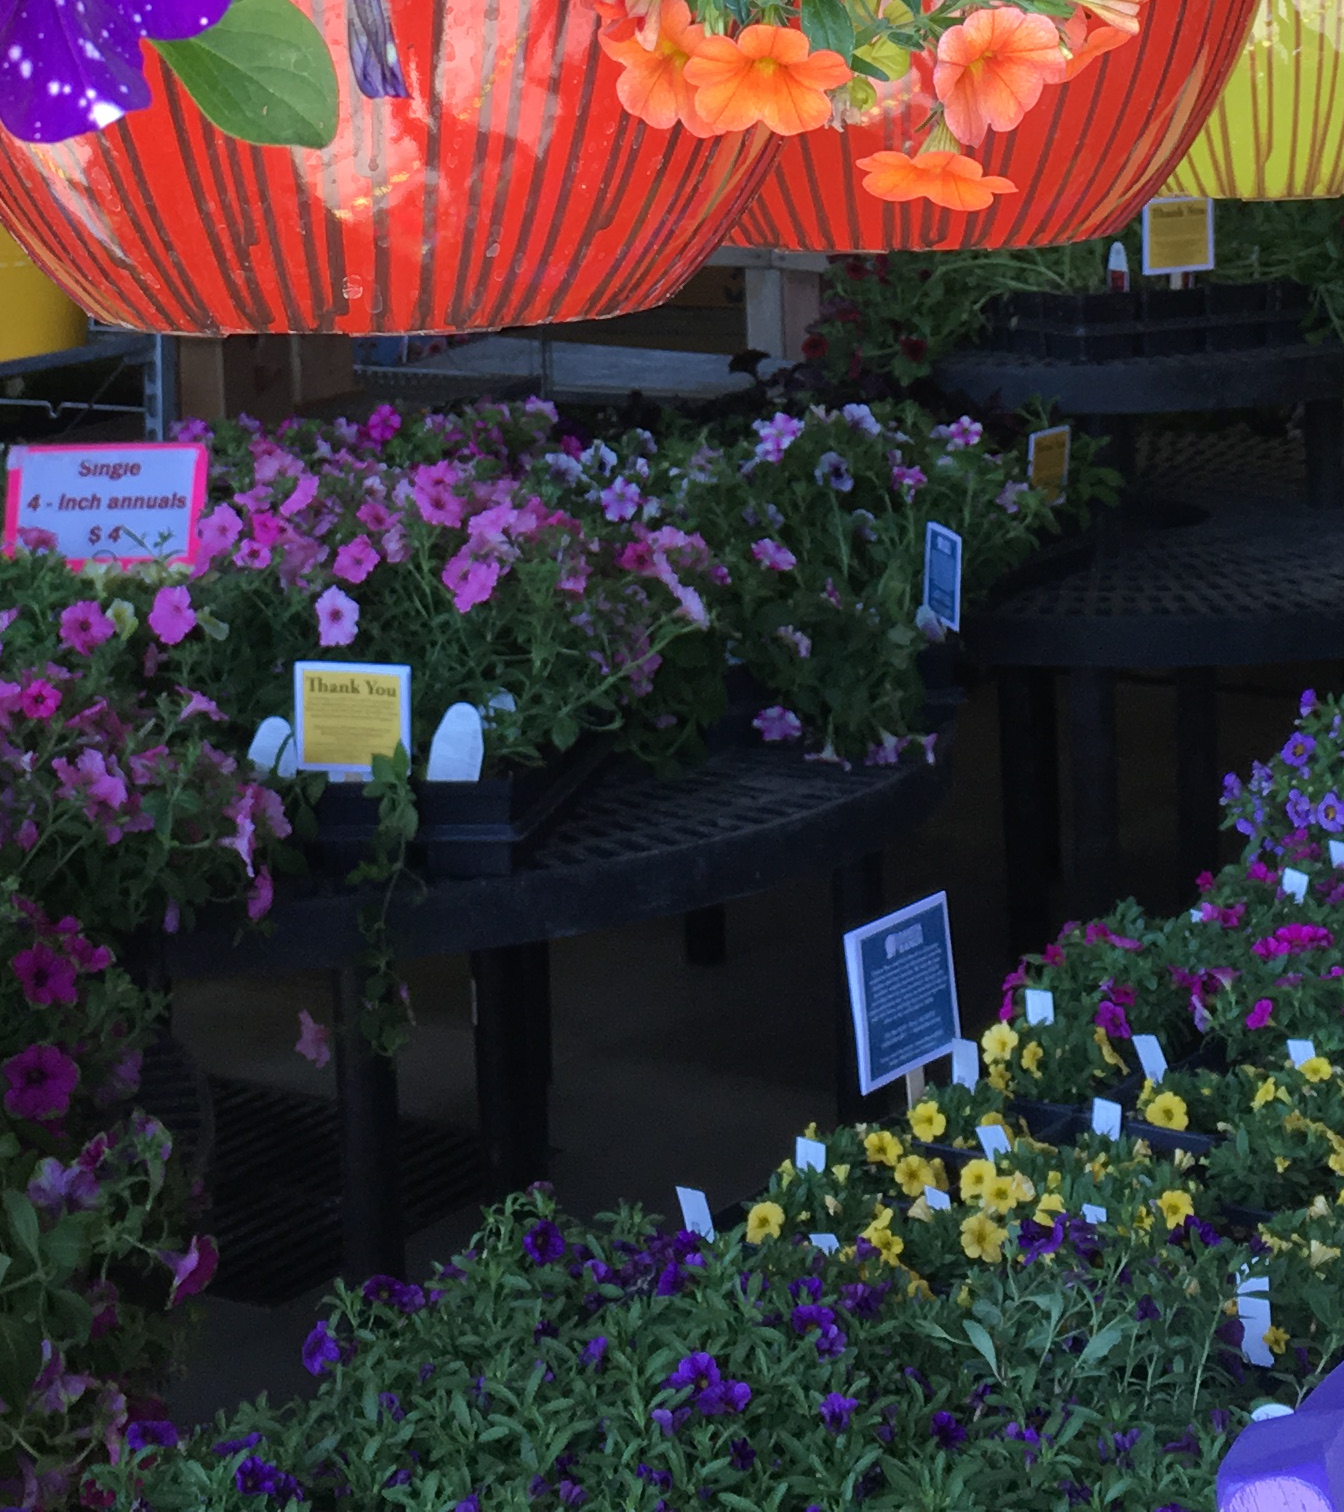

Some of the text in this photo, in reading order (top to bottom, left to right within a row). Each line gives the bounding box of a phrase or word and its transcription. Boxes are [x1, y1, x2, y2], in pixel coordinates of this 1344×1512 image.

[78, 458, 142, 481] Single
[27, 494, 40, 512] 4
[107, 492, 188, 511] annuals
[306, 676, 398, 697] Thank You
